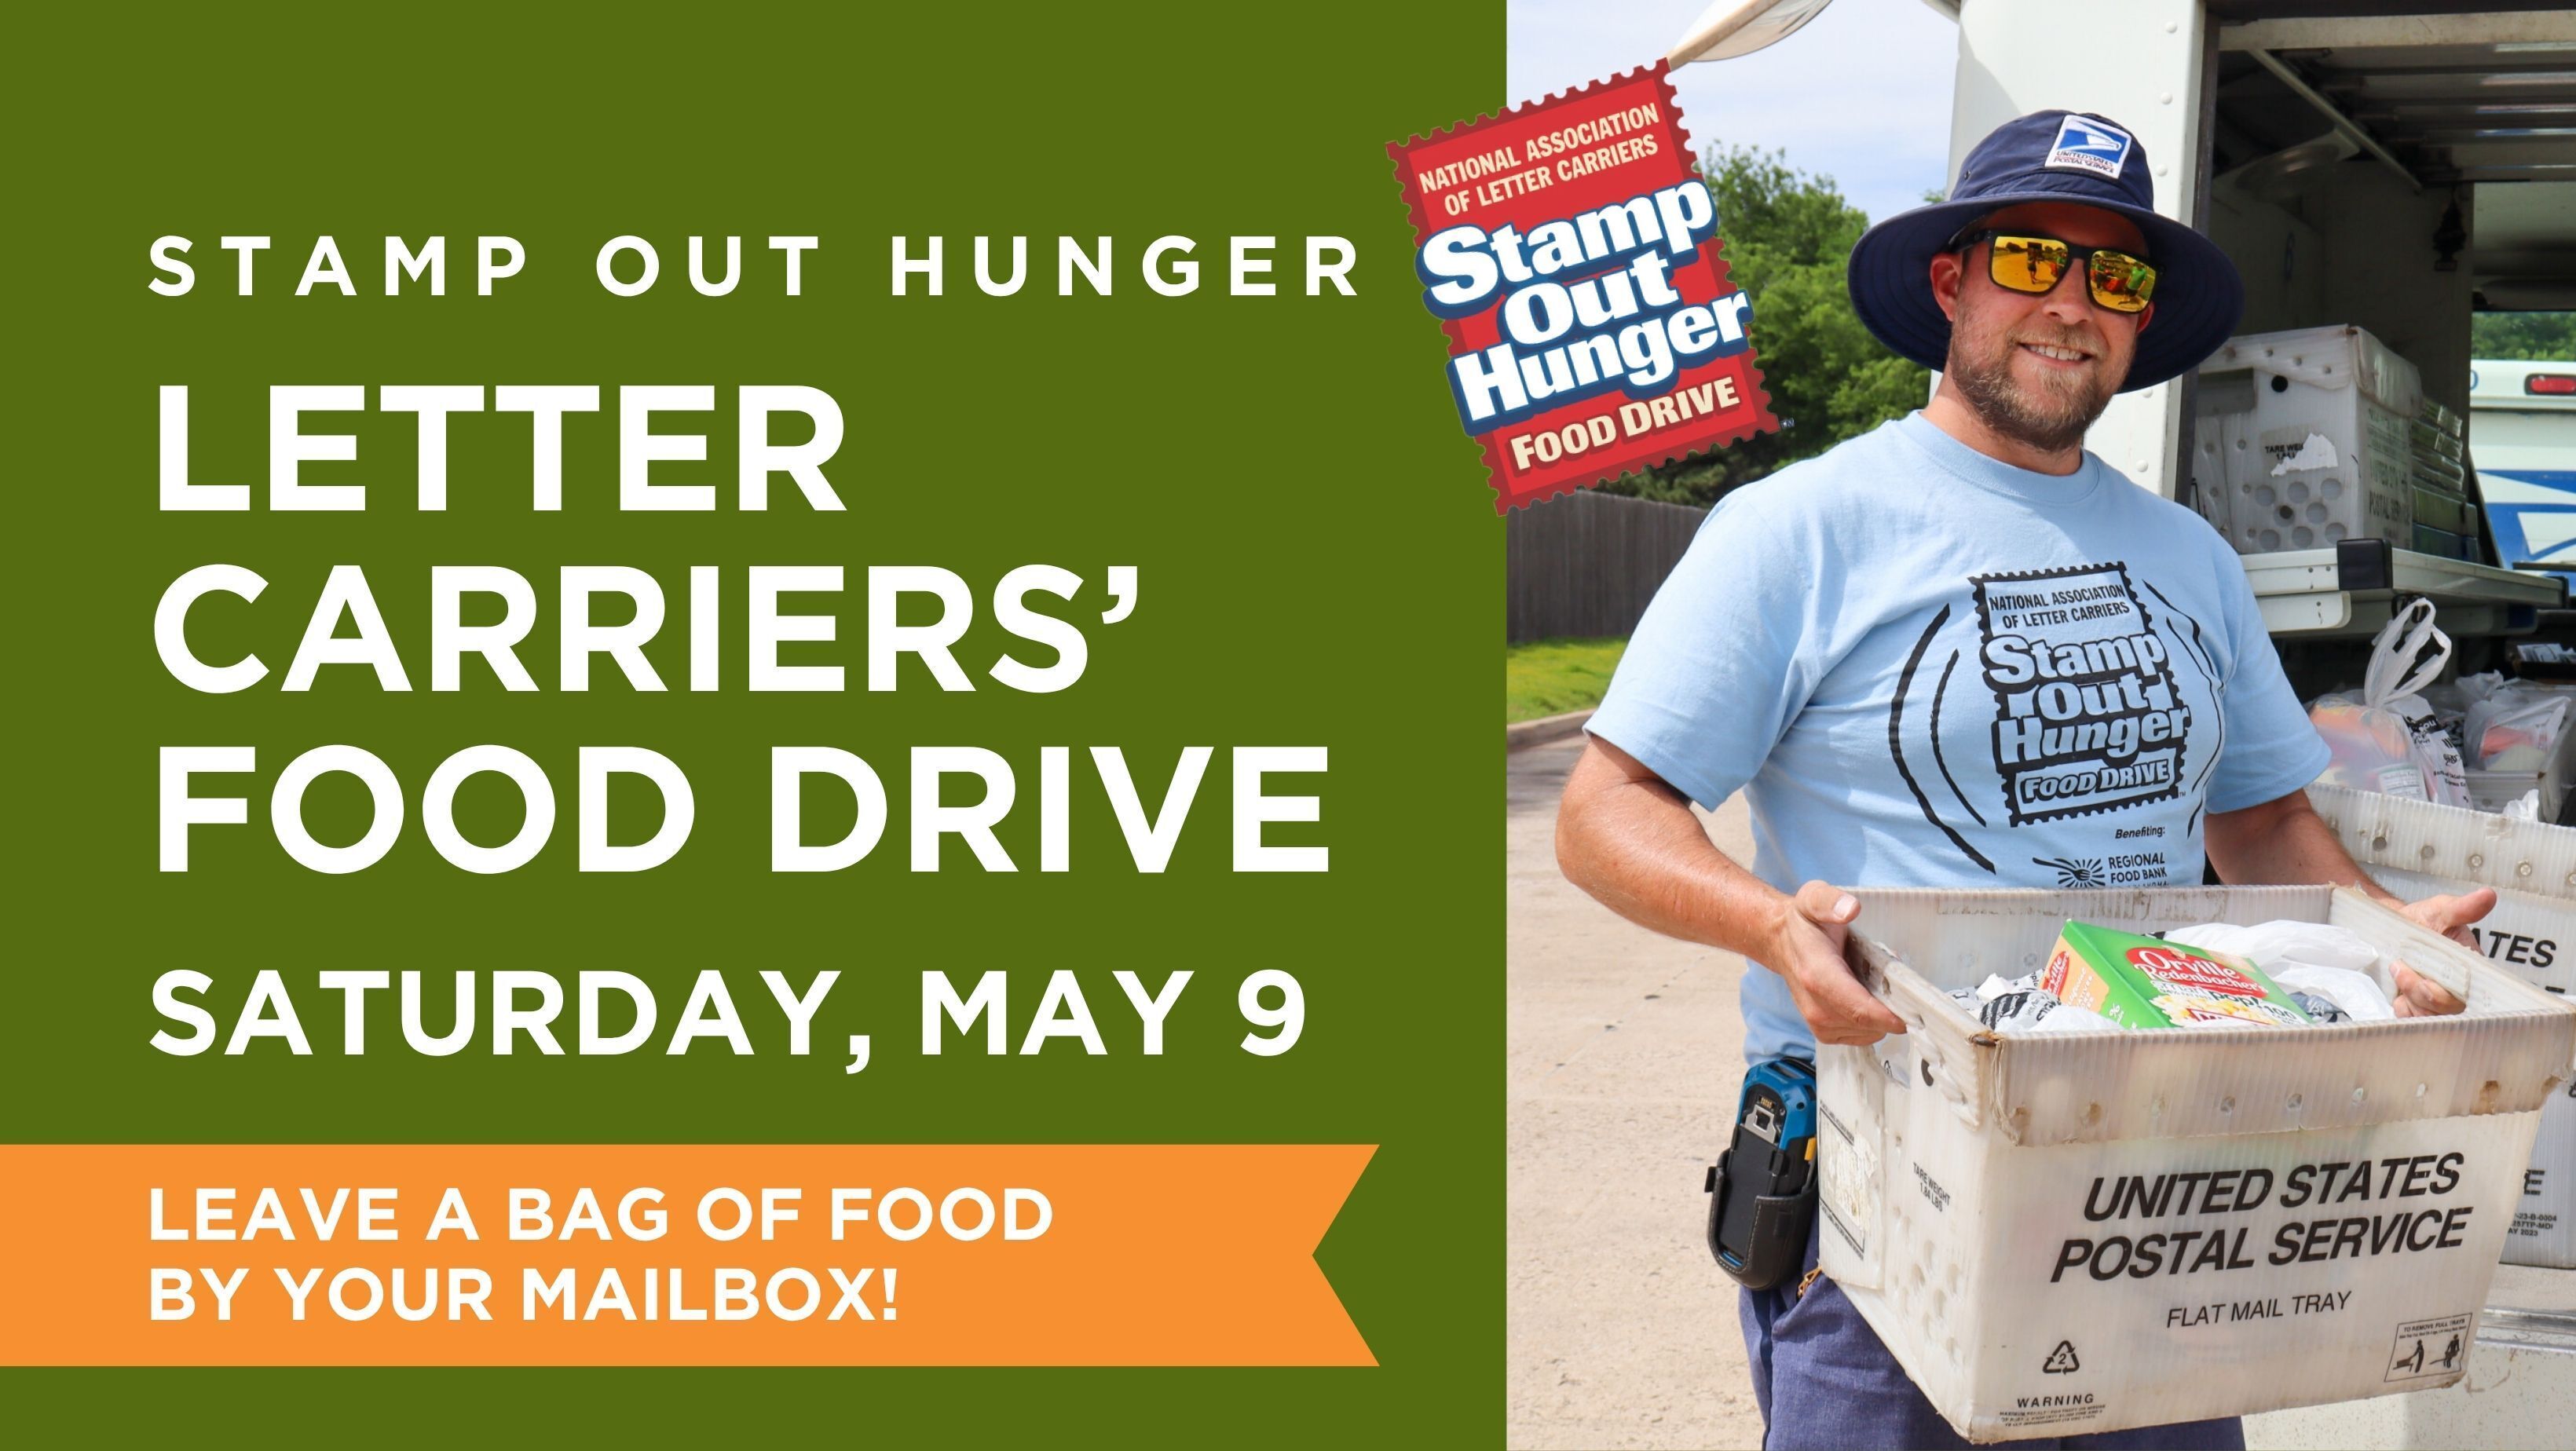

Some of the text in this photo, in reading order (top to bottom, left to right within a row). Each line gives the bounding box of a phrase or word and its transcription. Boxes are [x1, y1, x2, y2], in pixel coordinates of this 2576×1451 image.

[2286, 442, 2304, 451] WEI
[1989, 584, 2126, 611] NATIONAL ASSOCIATION
[2003, 601, 2131, 629] OF LETTER CARRIERS
[1985, 633, 2168, 685] Stamp
[2038, 672, 2150, 722] Out
[1997, 706, 2190, 765] Hunger
[2024, 759, 2170, 800] FOOD DRIVE
[2115, 826, 2165, 839] Benefiting:
[2108, 852, 2165, 869] REGIONAL
[2110, 870, 2140, 884] FOOD
[2142, 867, 2168, 880] BANK
[2133, 963, 2269, 994] Redenbacher's
[2138, 950, 2241, 979] Orville
[1913, 1162, 1950, 1206] TARE WEIGHT
[2083, 1168, 2274, 1222] UNITED
[2280, 1152, 2464, 1208] STATES
[1931, 1193, 1943, 1212] LBS
[2050, 1206, 2474, 1283] POSTAL SERVICE
[2167, 1291, 2352, 1328] FLAT MAIL TRAY
[2058, 1353, 2066, 1365] 2
[2017, 1394, 2095, 1408] WARNING
